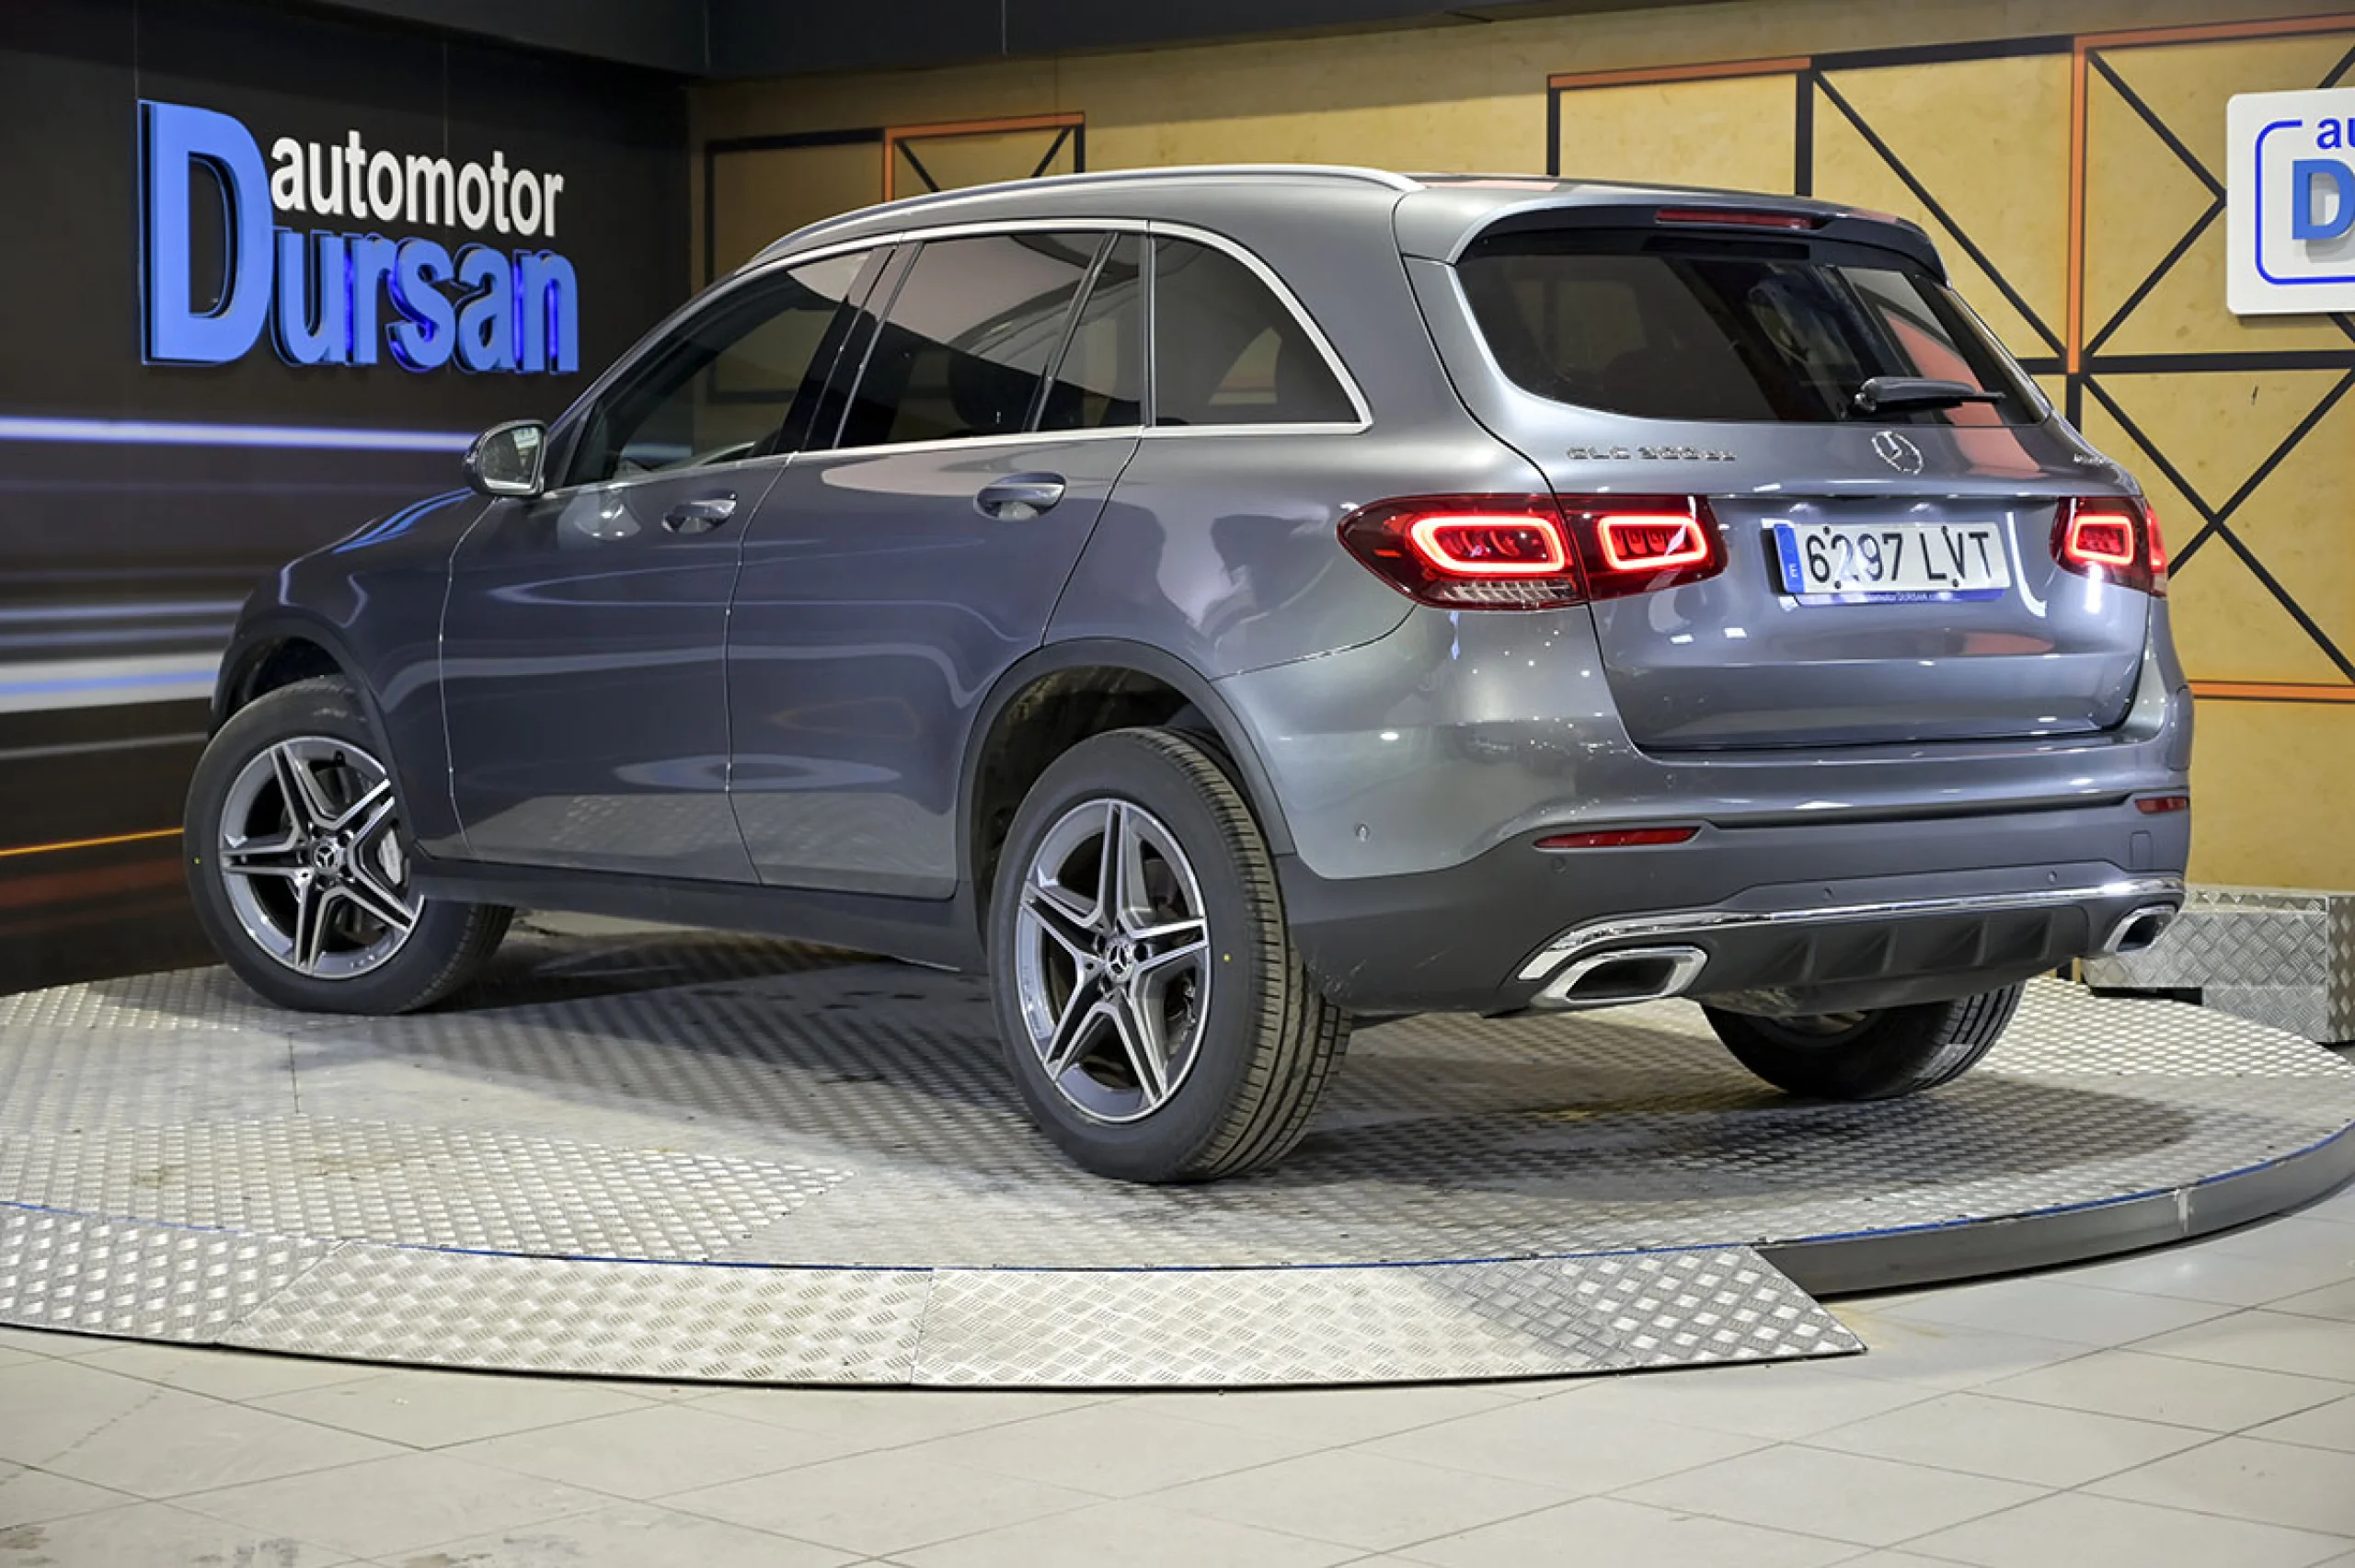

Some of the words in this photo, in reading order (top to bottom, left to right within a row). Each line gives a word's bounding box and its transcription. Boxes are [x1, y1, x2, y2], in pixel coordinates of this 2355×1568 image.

[270, 130, 564, 236] automotor
[138, 98, 580, 374] Dursan
[1567, 445, 1630, 460] GLC
[1805, 532, 1902, 583] 6297
[1919, 531, 1989, 580] LVT
